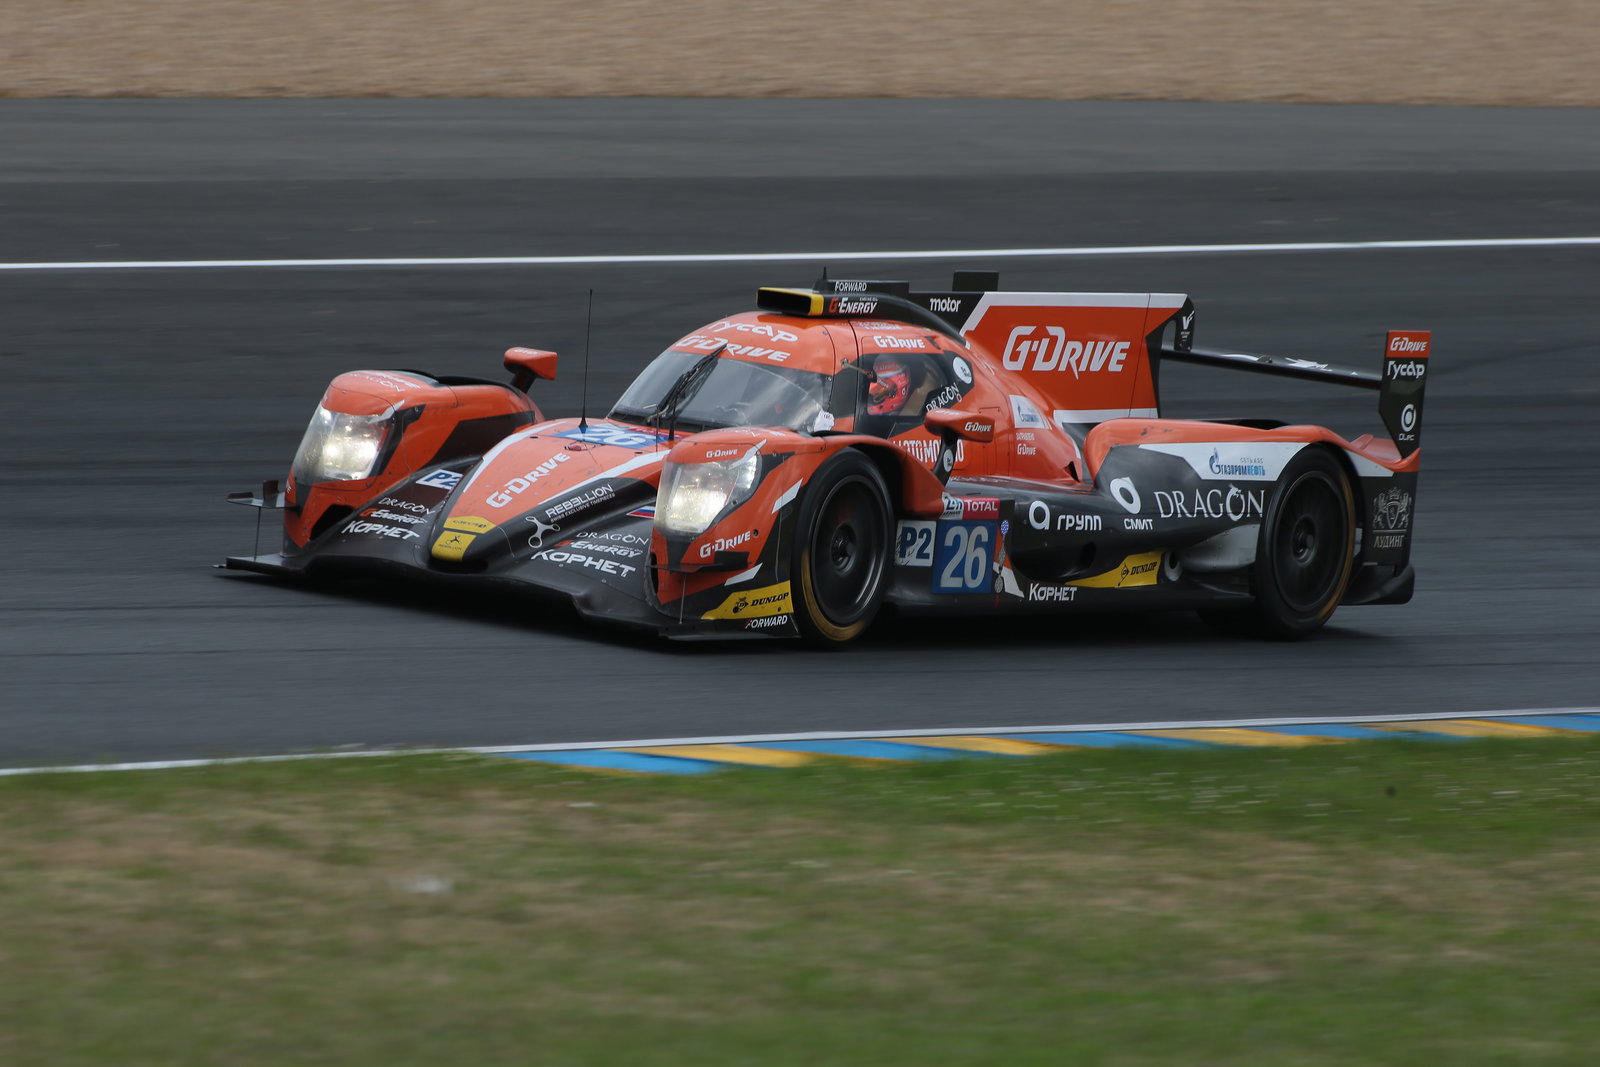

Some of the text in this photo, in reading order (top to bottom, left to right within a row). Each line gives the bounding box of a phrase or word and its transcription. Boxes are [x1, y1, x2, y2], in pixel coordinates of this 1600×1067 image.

[835, 281, 867, 292] FORWARD
[930, 297, 961, 312] motor
[424, 472, 459, 487] P2
[379, 497, 435, 515] DRAGON
[545, 484, 614, 518] REBELLION
[964, 500, 998, 511] TOTAL
[1154, 484, 1265, 522] DRAGON
[576, 531, 649, 546] DRAGON
[900, 527, 932, 559] P2
[1374, 535, 1405, 548] ЛУДИНГ
[940, 526, 989, 588] 26
[1130, 562, 1157, 575] DUNLOP
[751, 592, 789, 607] DUNLOP
[745, 615, 788, 629] FORWARD
